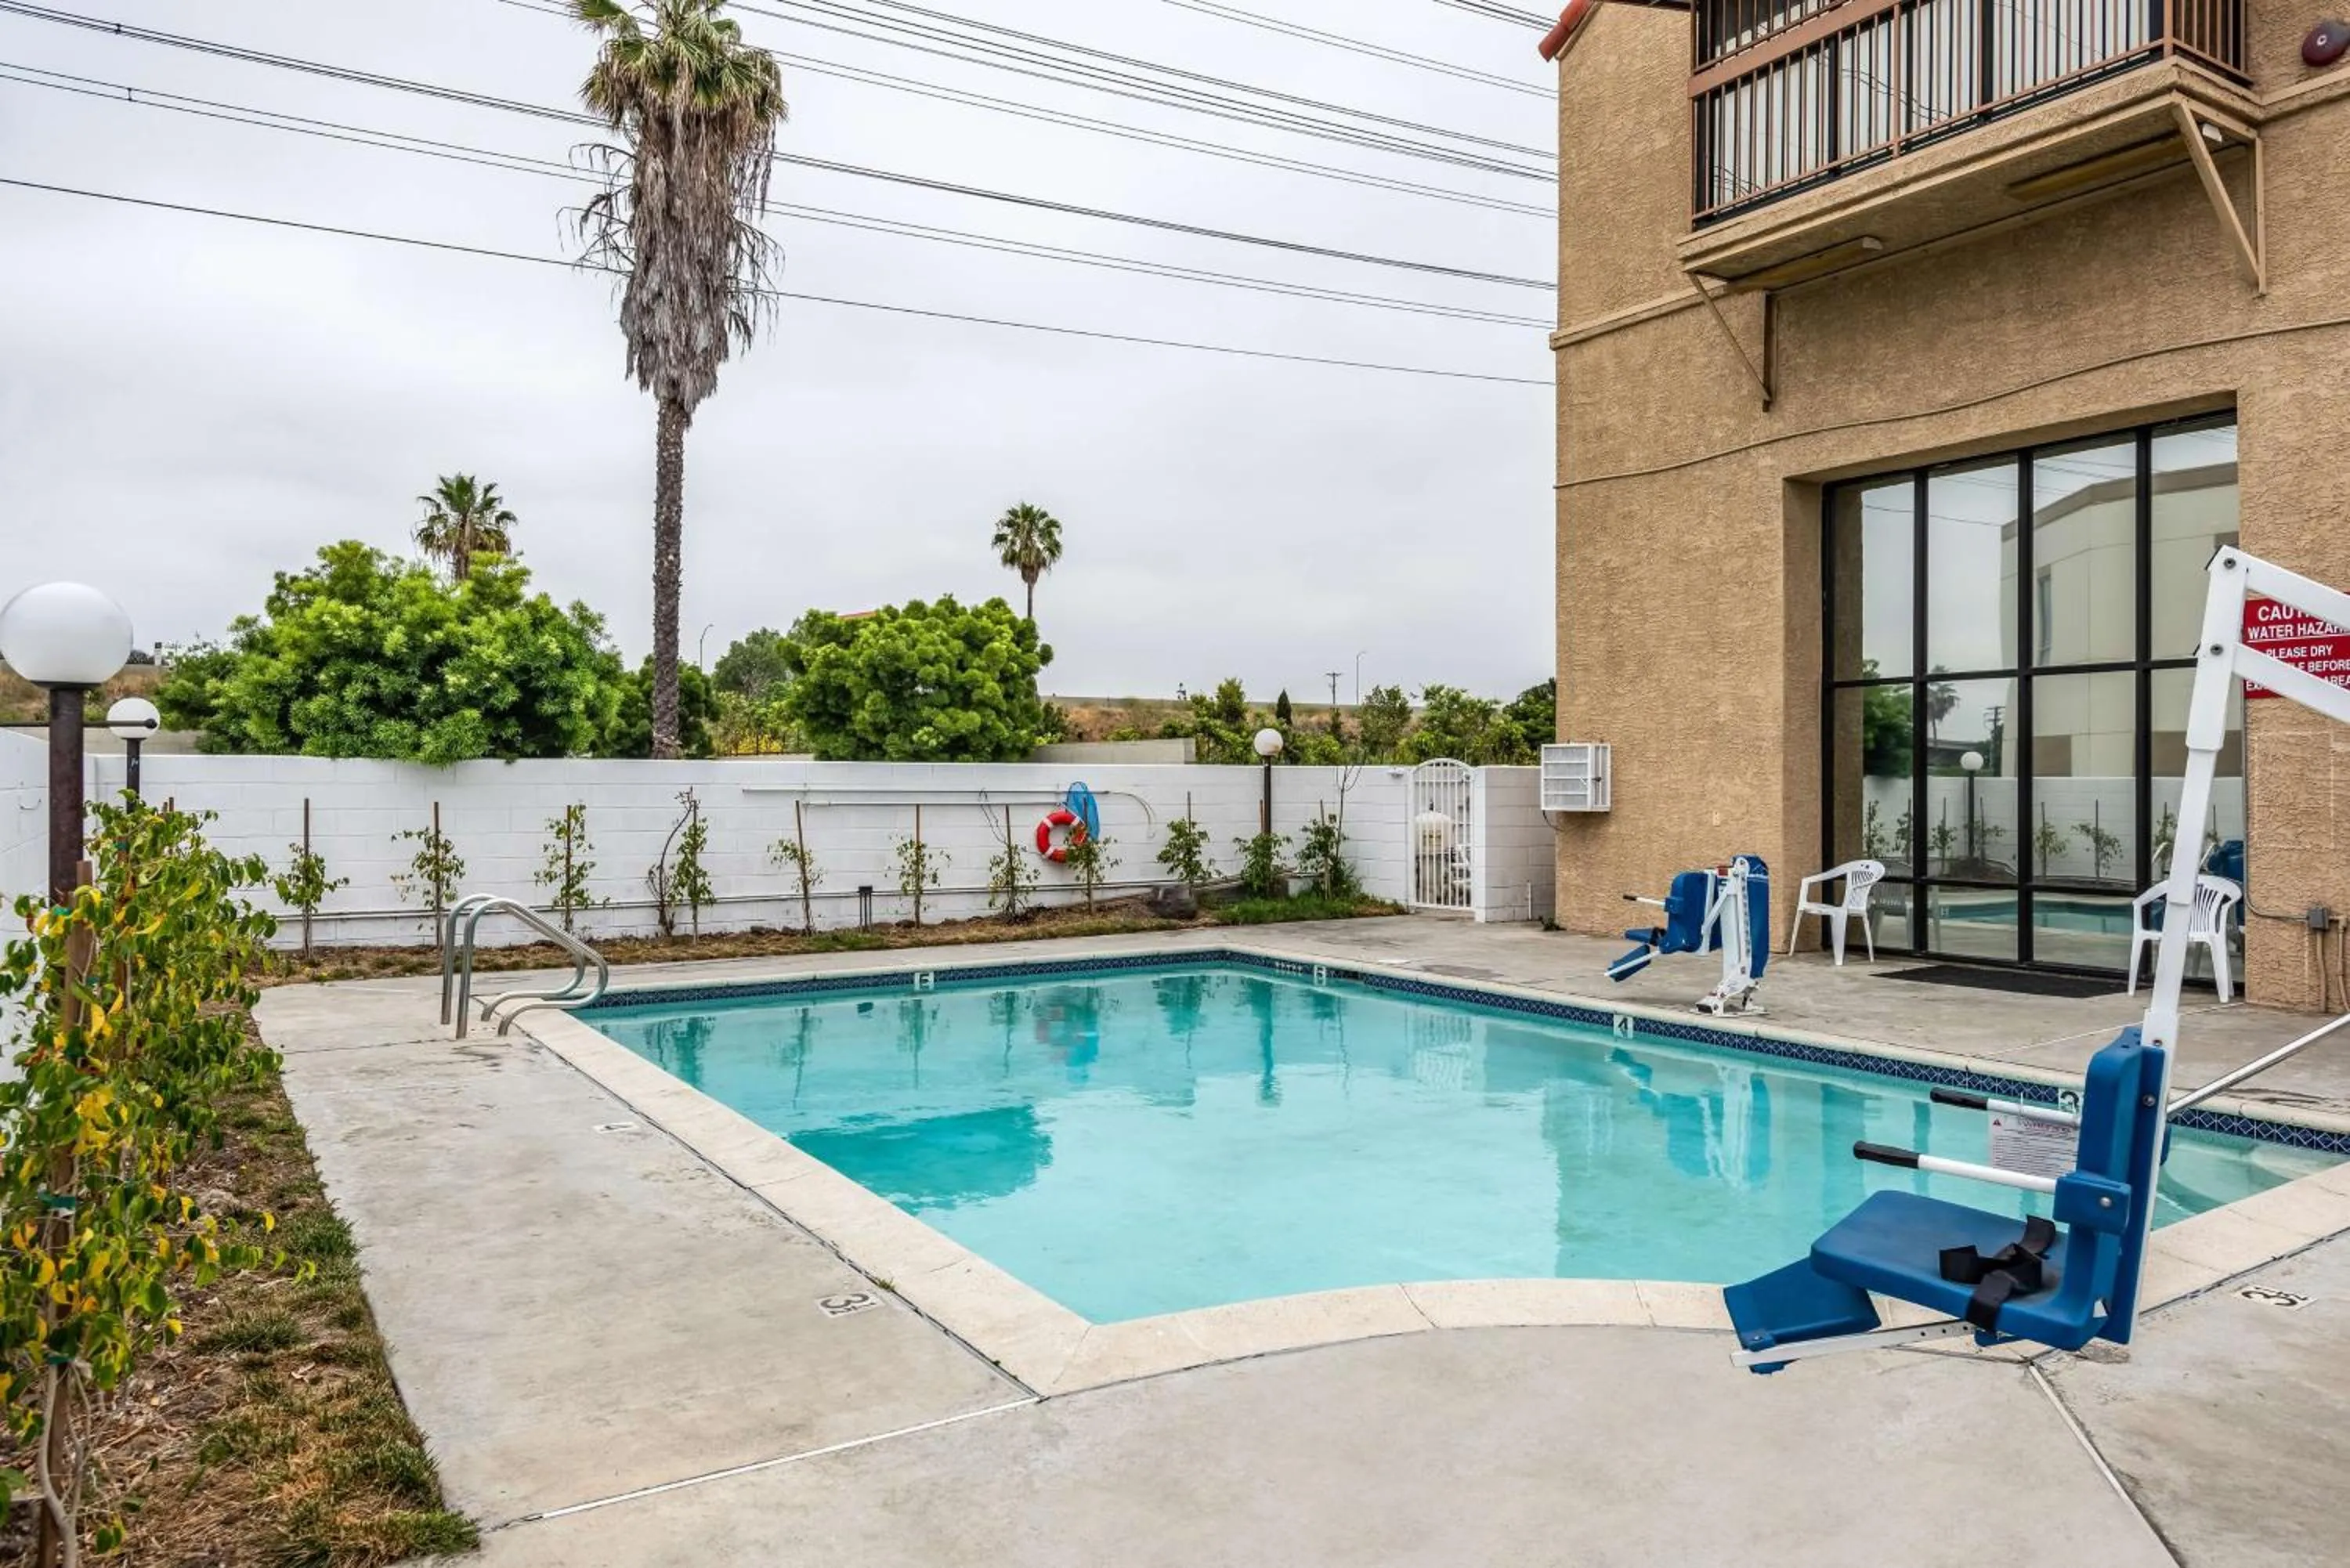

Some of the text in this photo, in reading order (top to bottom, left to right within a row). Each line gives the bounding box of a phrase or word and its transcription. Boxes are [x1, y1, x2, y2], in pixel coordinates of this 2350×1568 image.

[2247, 624, 2294, 640] WATER
[2265, 645, 2334, 659] PLEASE DRY
